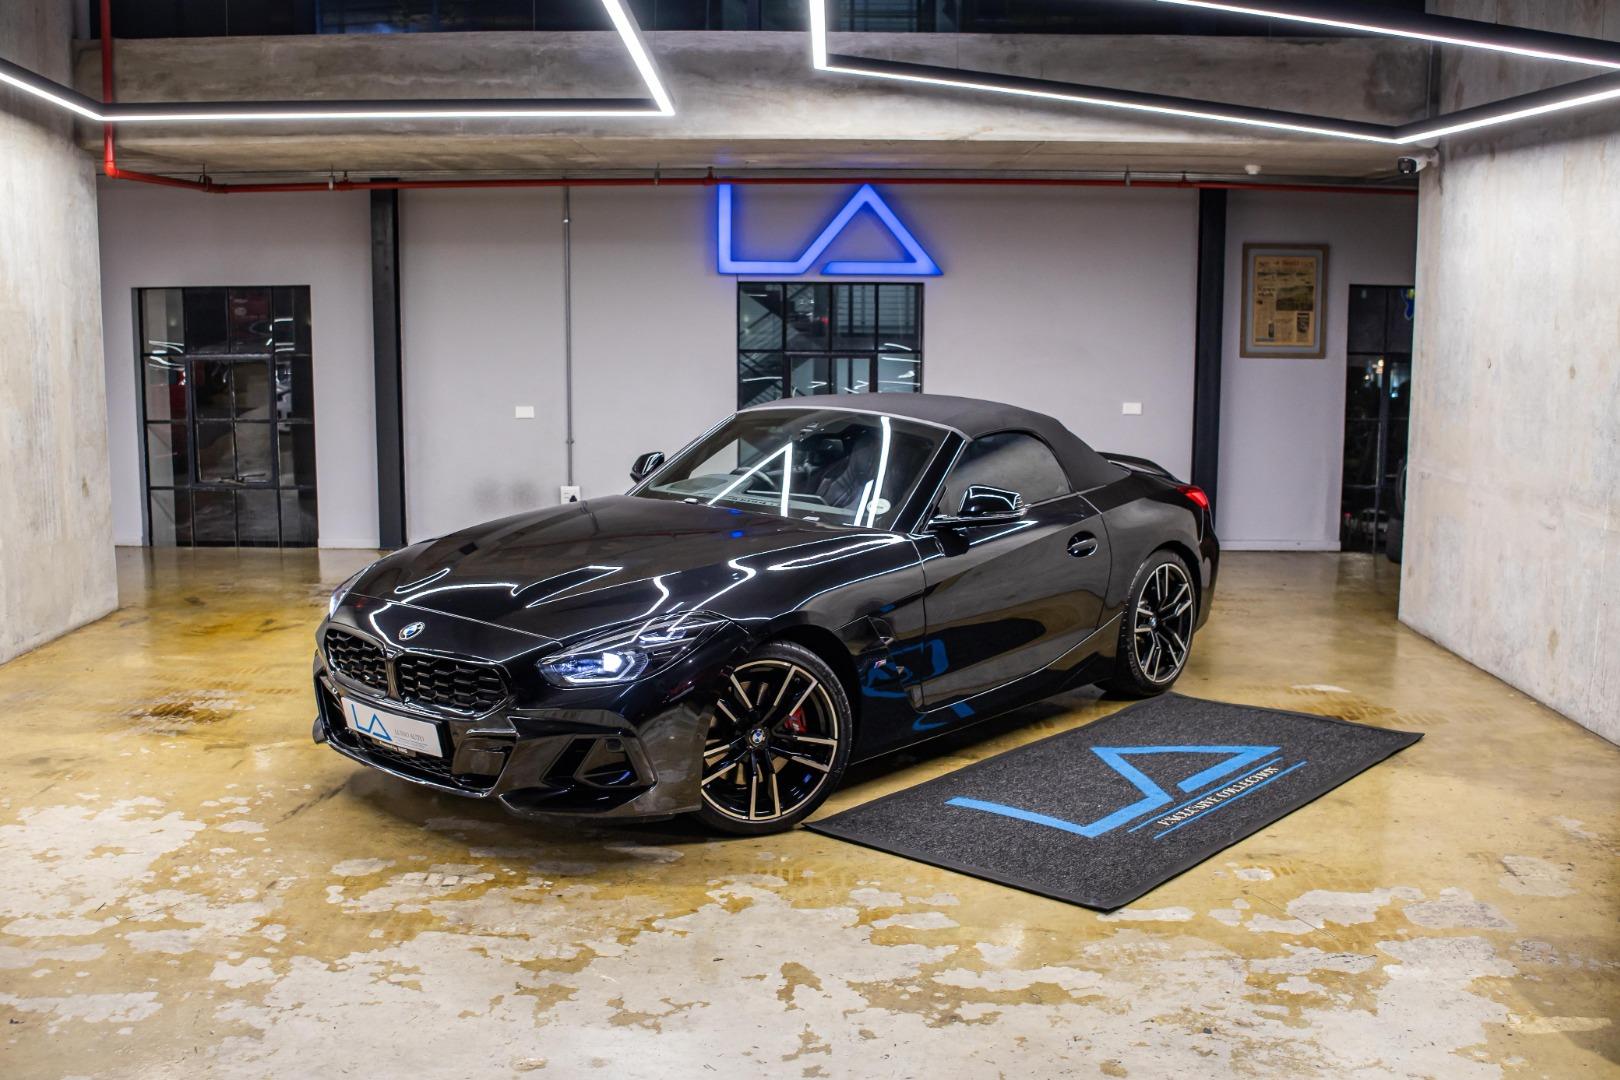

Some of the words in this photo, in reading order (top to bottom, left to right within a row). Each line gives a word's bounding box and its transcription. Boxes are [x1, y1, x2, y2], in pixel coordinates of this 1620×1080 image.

[718, 183, 944, 275] LA
[351, 703, 393, 741] LA
[1216, 766, 1279, 800] COLLECTION
